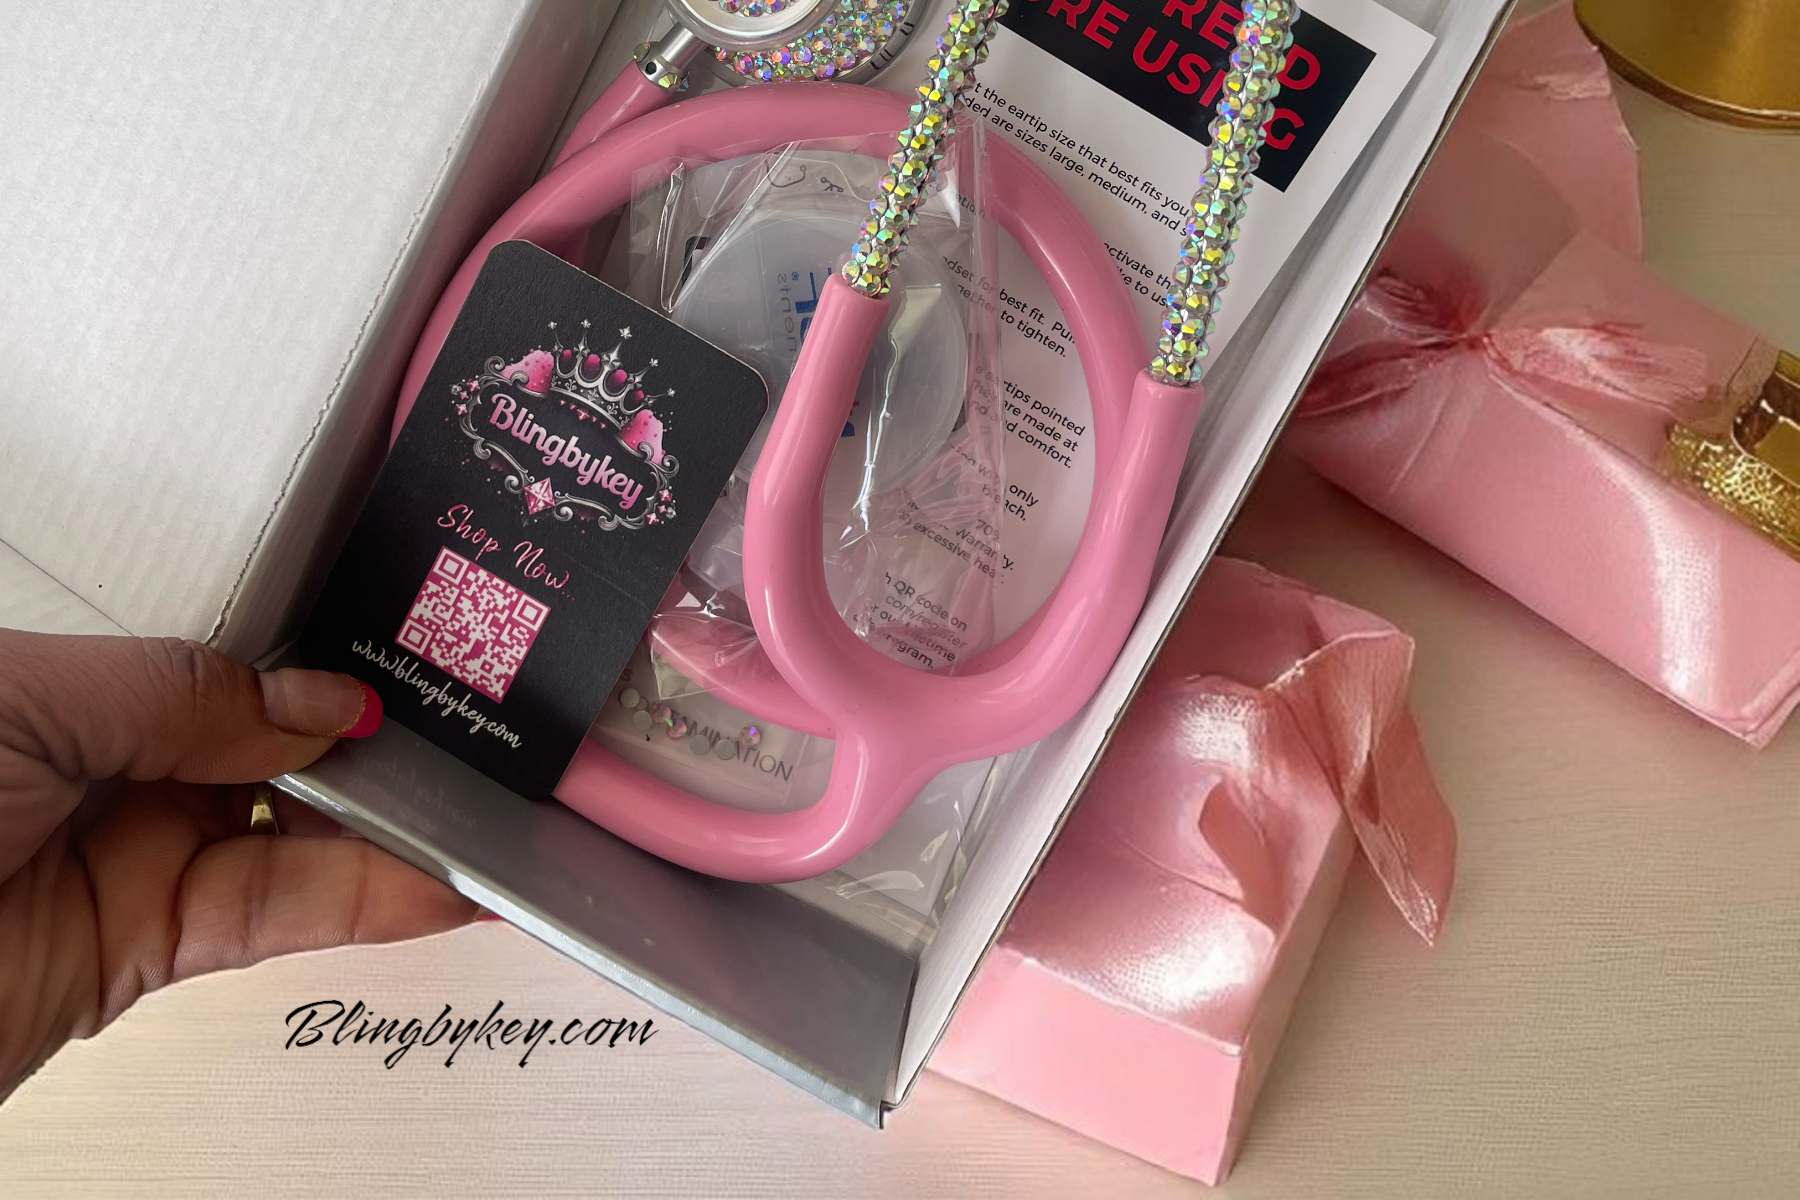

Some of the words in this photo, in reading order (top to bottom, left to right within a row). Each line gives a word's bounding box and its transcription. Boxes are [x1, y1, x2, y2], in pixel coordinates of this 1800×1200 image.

[1132, 27, 1305, 151] USIG
[983, 87, 1007, 108] the
[1008, 104, 1048, 133] eartip
[1049, 128, 1076, 150] size
[1077, 144, 1108, 168] that
[1108, 162, 1140, 187] best
[1139, 181, 1163, 201] fits
[991, 115, 1014, 132] are
[1014, 128, 1048, 153] sizes
[1049, 146, 1085, 177] large,
[1087, 171, 1147, 214] medium,
[1151, 210, 1181, 231] and
[999, 288, 1029, 314] best
[1030, 308, 1045, 326] fit.
[1134, 281, 1149, 295] to
[1150, 292, 1168, 308] us
[1000, 309, 1015, 324] to
[1016, 318, 1066, 358] tighten.
[1022, 413, 1062, 441] made
[1062, 438, 1079, 452] at
[1030, 399, 1086, 436] pointed
[489, 392, 644, 511] Blingbykey
[1018, 429, 1071, 469] comfort.
[1009, 484, 1039, 508] only
[437, 503, 501, 562] Shop
[913, 522, 972, 562] excessive
[894, 580, 916, 599] QR
[917, 595, 949, 620] code
[950, 616, 968, 632] on
[351, 639, 523, 749] www.blingbykey.com
